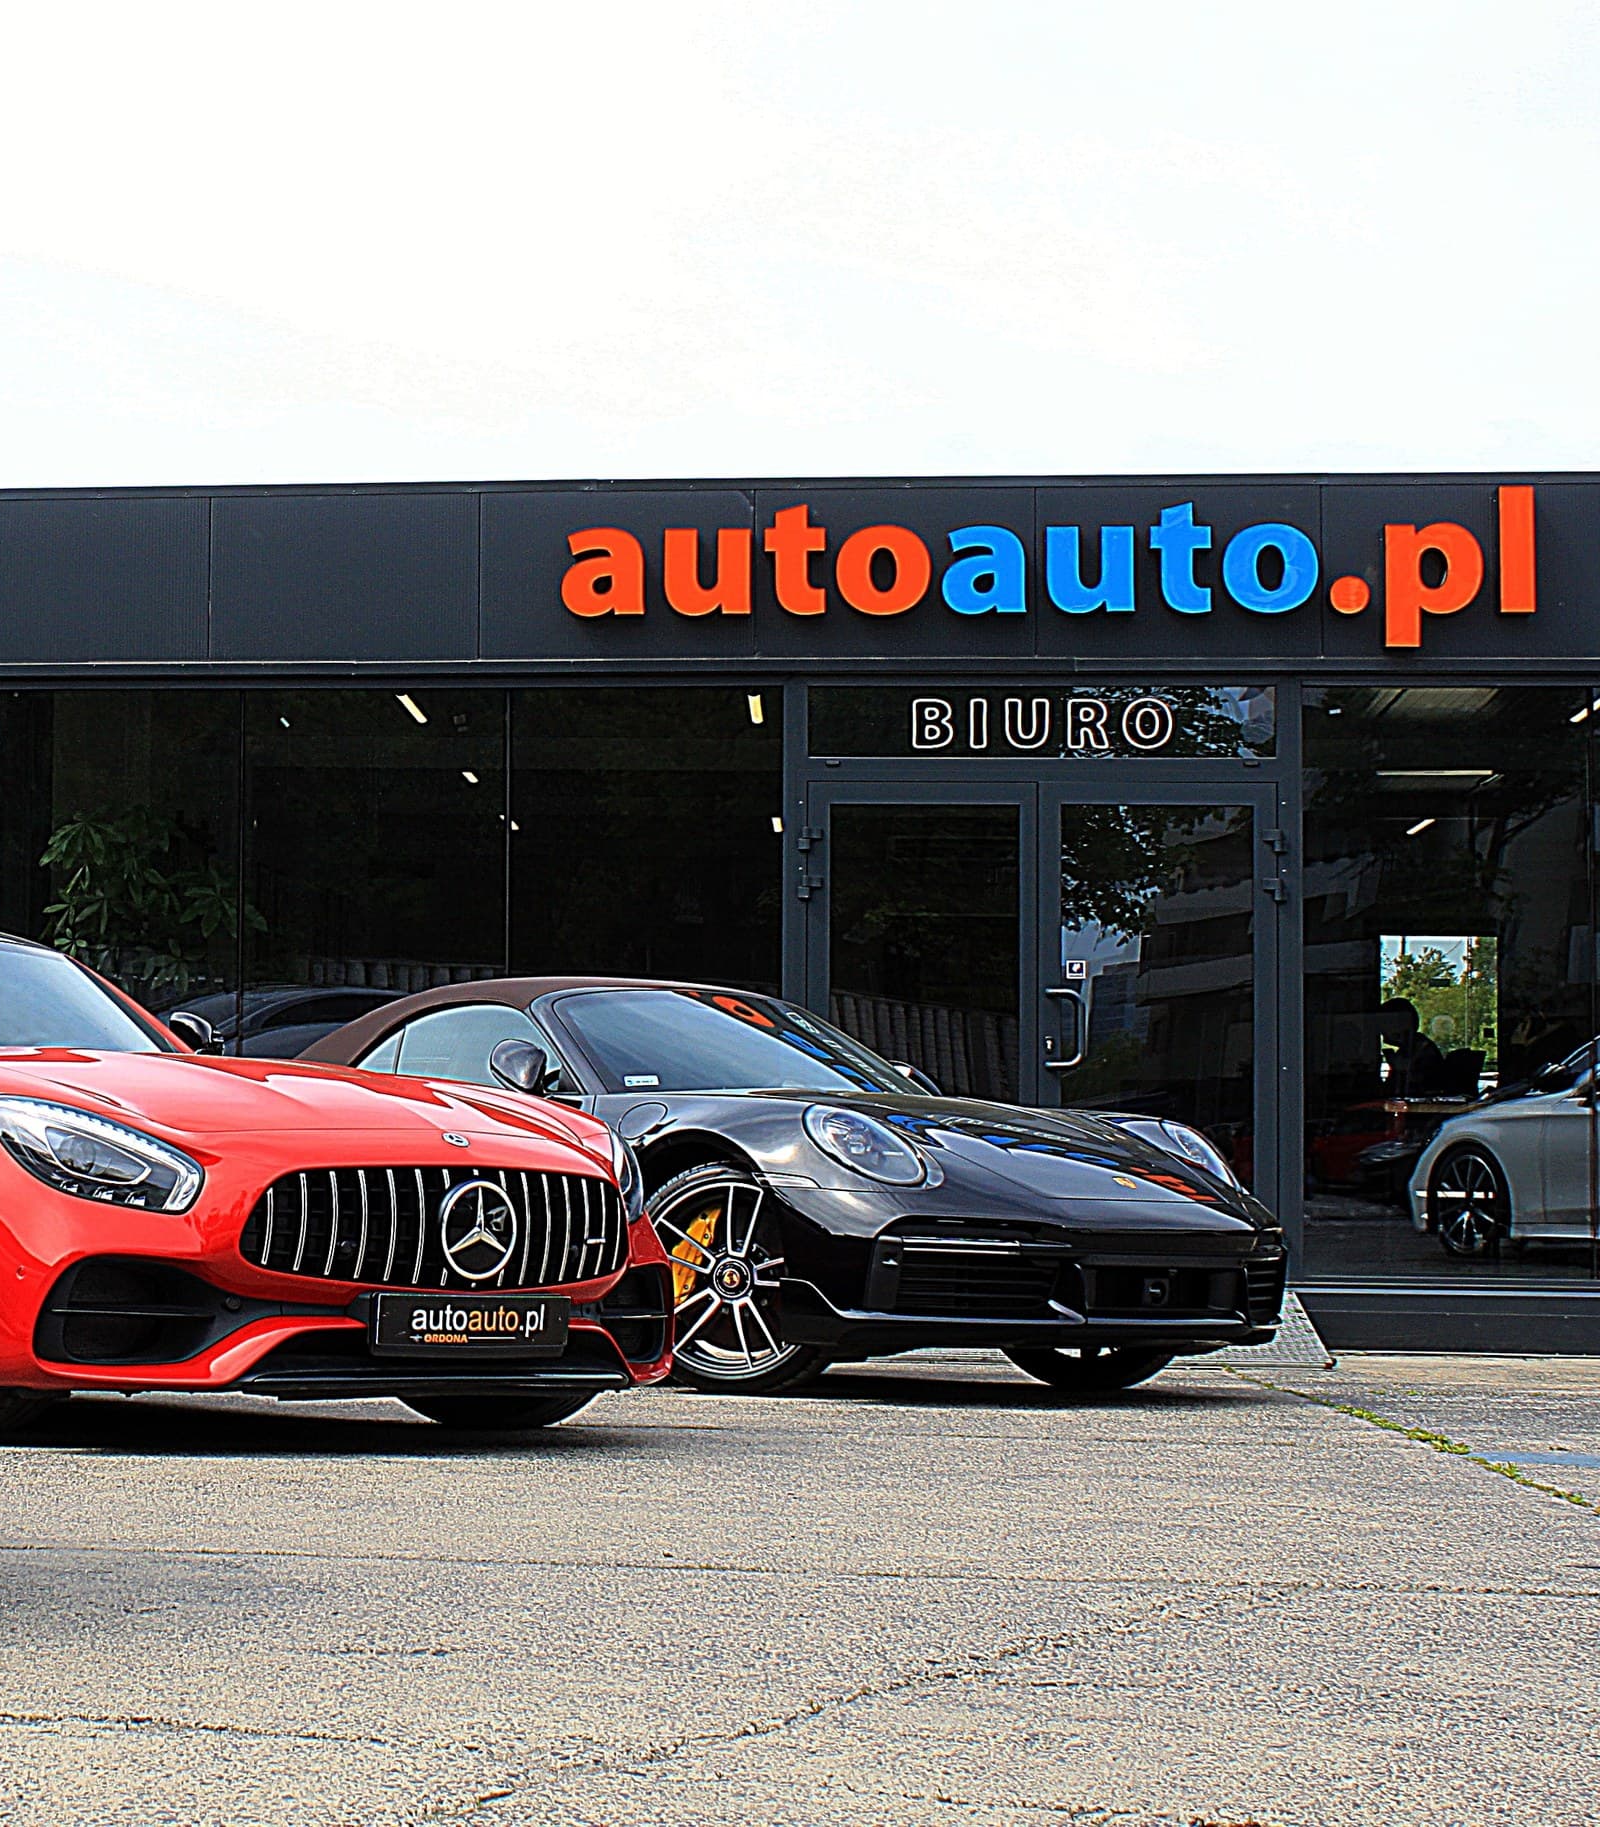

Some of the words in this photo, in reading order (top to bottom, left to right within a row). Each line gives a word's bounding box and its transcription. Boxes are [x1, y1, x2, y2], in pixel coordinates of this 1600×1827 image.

[560, 484, 1536, 648] autoauto.pl
[911, 697, 1176, 751] BIURO
[411, 1303, 546, 1338] autoauto.pl
[423, 1333, 469, 1344] ORDONA
